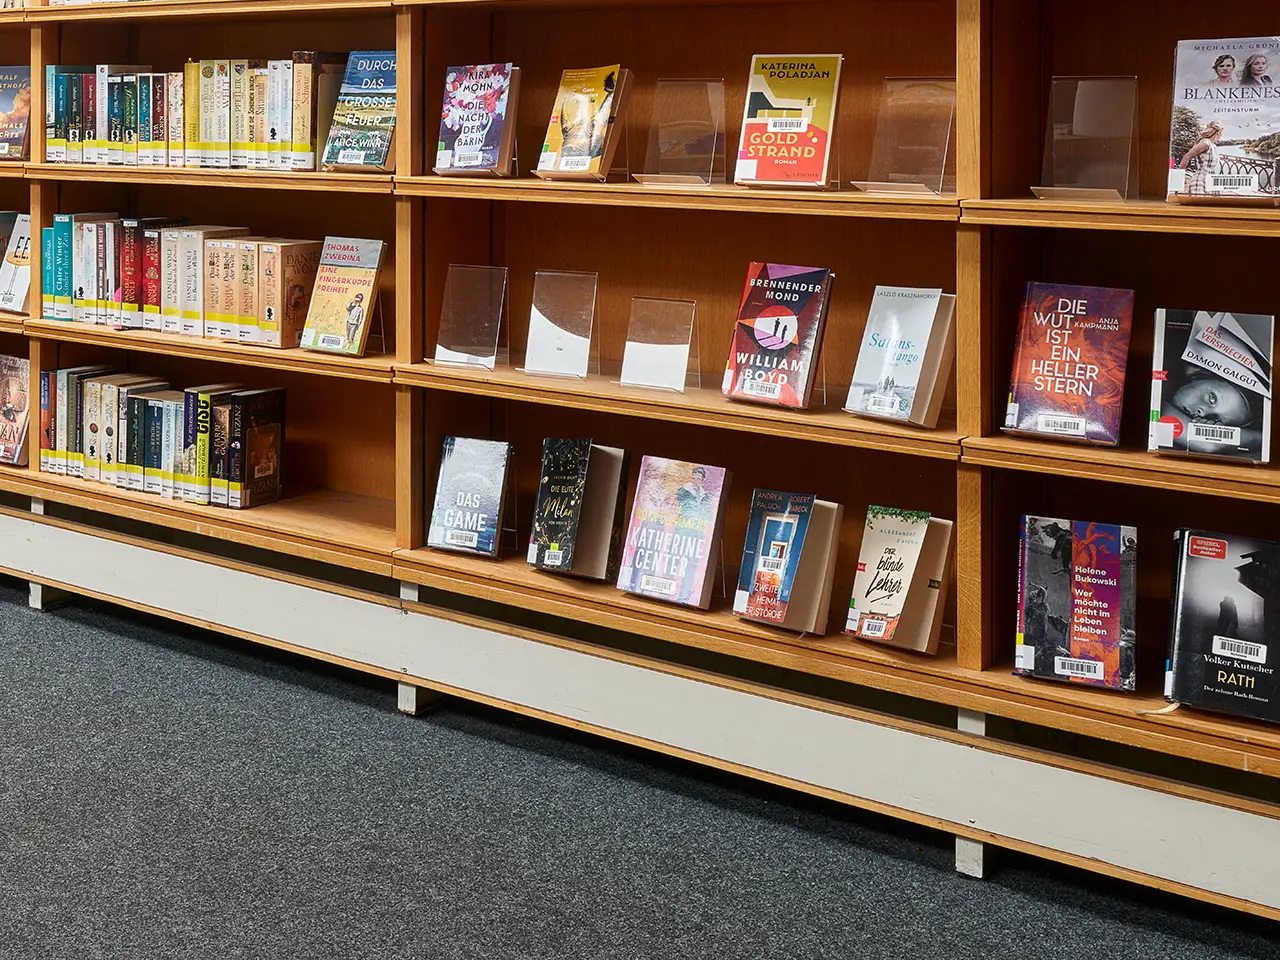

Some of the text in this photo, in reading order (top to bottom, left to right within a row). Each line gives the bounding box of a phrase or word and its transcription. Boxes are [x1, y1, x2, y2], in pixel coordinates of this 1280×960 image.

[357, 60, 397, 71] DURCH
[761, 62, 816, 70] KATERINA
[468, 71, 491, 80] KIRA
[769, 71, 830, 79] POLADJAN
[361, 78, 385, 89] DAS
[462, 80, 493, 92] MÖHN
[222, 81, 230, 108] WELT
[302, 76, 310, 105] Schwur
[256, 81, 265, 116] Savannah
[345, 96, 393, 107] GROSSE
[467, 101, 484, 111] DIE
[345, 115, 382, 126] FEUER
[458, 112, 489, 123] NACHT
[463, 125, 482, 134] DER
[332, 139, 382, 148] ALICE WINN
[457, 136, 484, 147] BÄRIN
[749, 132, 798, 145] GOLD
[747, 145, 816, 158] STRAND
[326, 243, 360, 252] THOMAS
[324, 252, 361, 263] ZWERINA
[321, 266, 338, 274] EINE
[319, 275, 372, 287] FINGERKUPPE
[749, 278, 822, 293] BRENNENDER
[316, 284, 349, 294] FREIHEIT
[765, 290, 800, 302] MOND
[1057, 298, 1088, 315] DIE
[1033, 311, 1075, 329] WUT
[1074, 321, 1120, 331] KAMPMANN
[1098, 317, 1119, 325] ANJA
[1045, 329, 1073, 345] IST
[1205, 326, 1224, 339] DAS
[868, 331, 916, 349] Satans-
[1051, 345, 1081, 363] EIN
[1200, 332, 1256, 369] VERSPRECHEN
[736, 351, 804, 373] WILLIAM
[892, 349, 919, 366] tango
[1031, 360, 1099, 381] HELLER
[1186, 350, 1259, 388] DAMON GALGUT
[744, 366, 789, 386] BOYD
[1034, 376, 1093, 397] STERN
[234, 404, 242, 437] BYZANZ
[456, 491, 481, 508] DAS
[757, 492, 811, 504] ANDREA ROBERT
[542, 496, 574, 519] Milan
[756, 501, 781, 511] PALUCH
[444, 510, 488, 532] GAME
[880, 529, 917, 538] ALESSANDRO
[630, 526, 705, 559] KATHERINE
[883, 547, 896, 556] DER
[635, 549, 689, 578] CENTER
[877, 555, 905, 573] blinde
[760, 572, 772, 581] DIE
[1075, 565, 1107, 576] Helene
[865, 571, 903, 599] Lehrer
[1075, 574, 1117, 587] Bukowski
[754, 583, 780, 594] ZWEITE
[1074, 588, 1093, 597] Wer
[756, 595, 781, 606] HEIMAT
[1074, 597, 1109, 609] möchte
[754, 606, 783, 620] STÖRCHE
[1074, 606, 1110, 618] nicht im
[1074, 615, 1102, 626] Leben
[1074, 624, 1108, 636] bleiben
[1203, 653, 1274, 675] Volker Kutscher
[1217, 670, 1255, 689] RATH
[1203, 684, 1215, 692] Der
